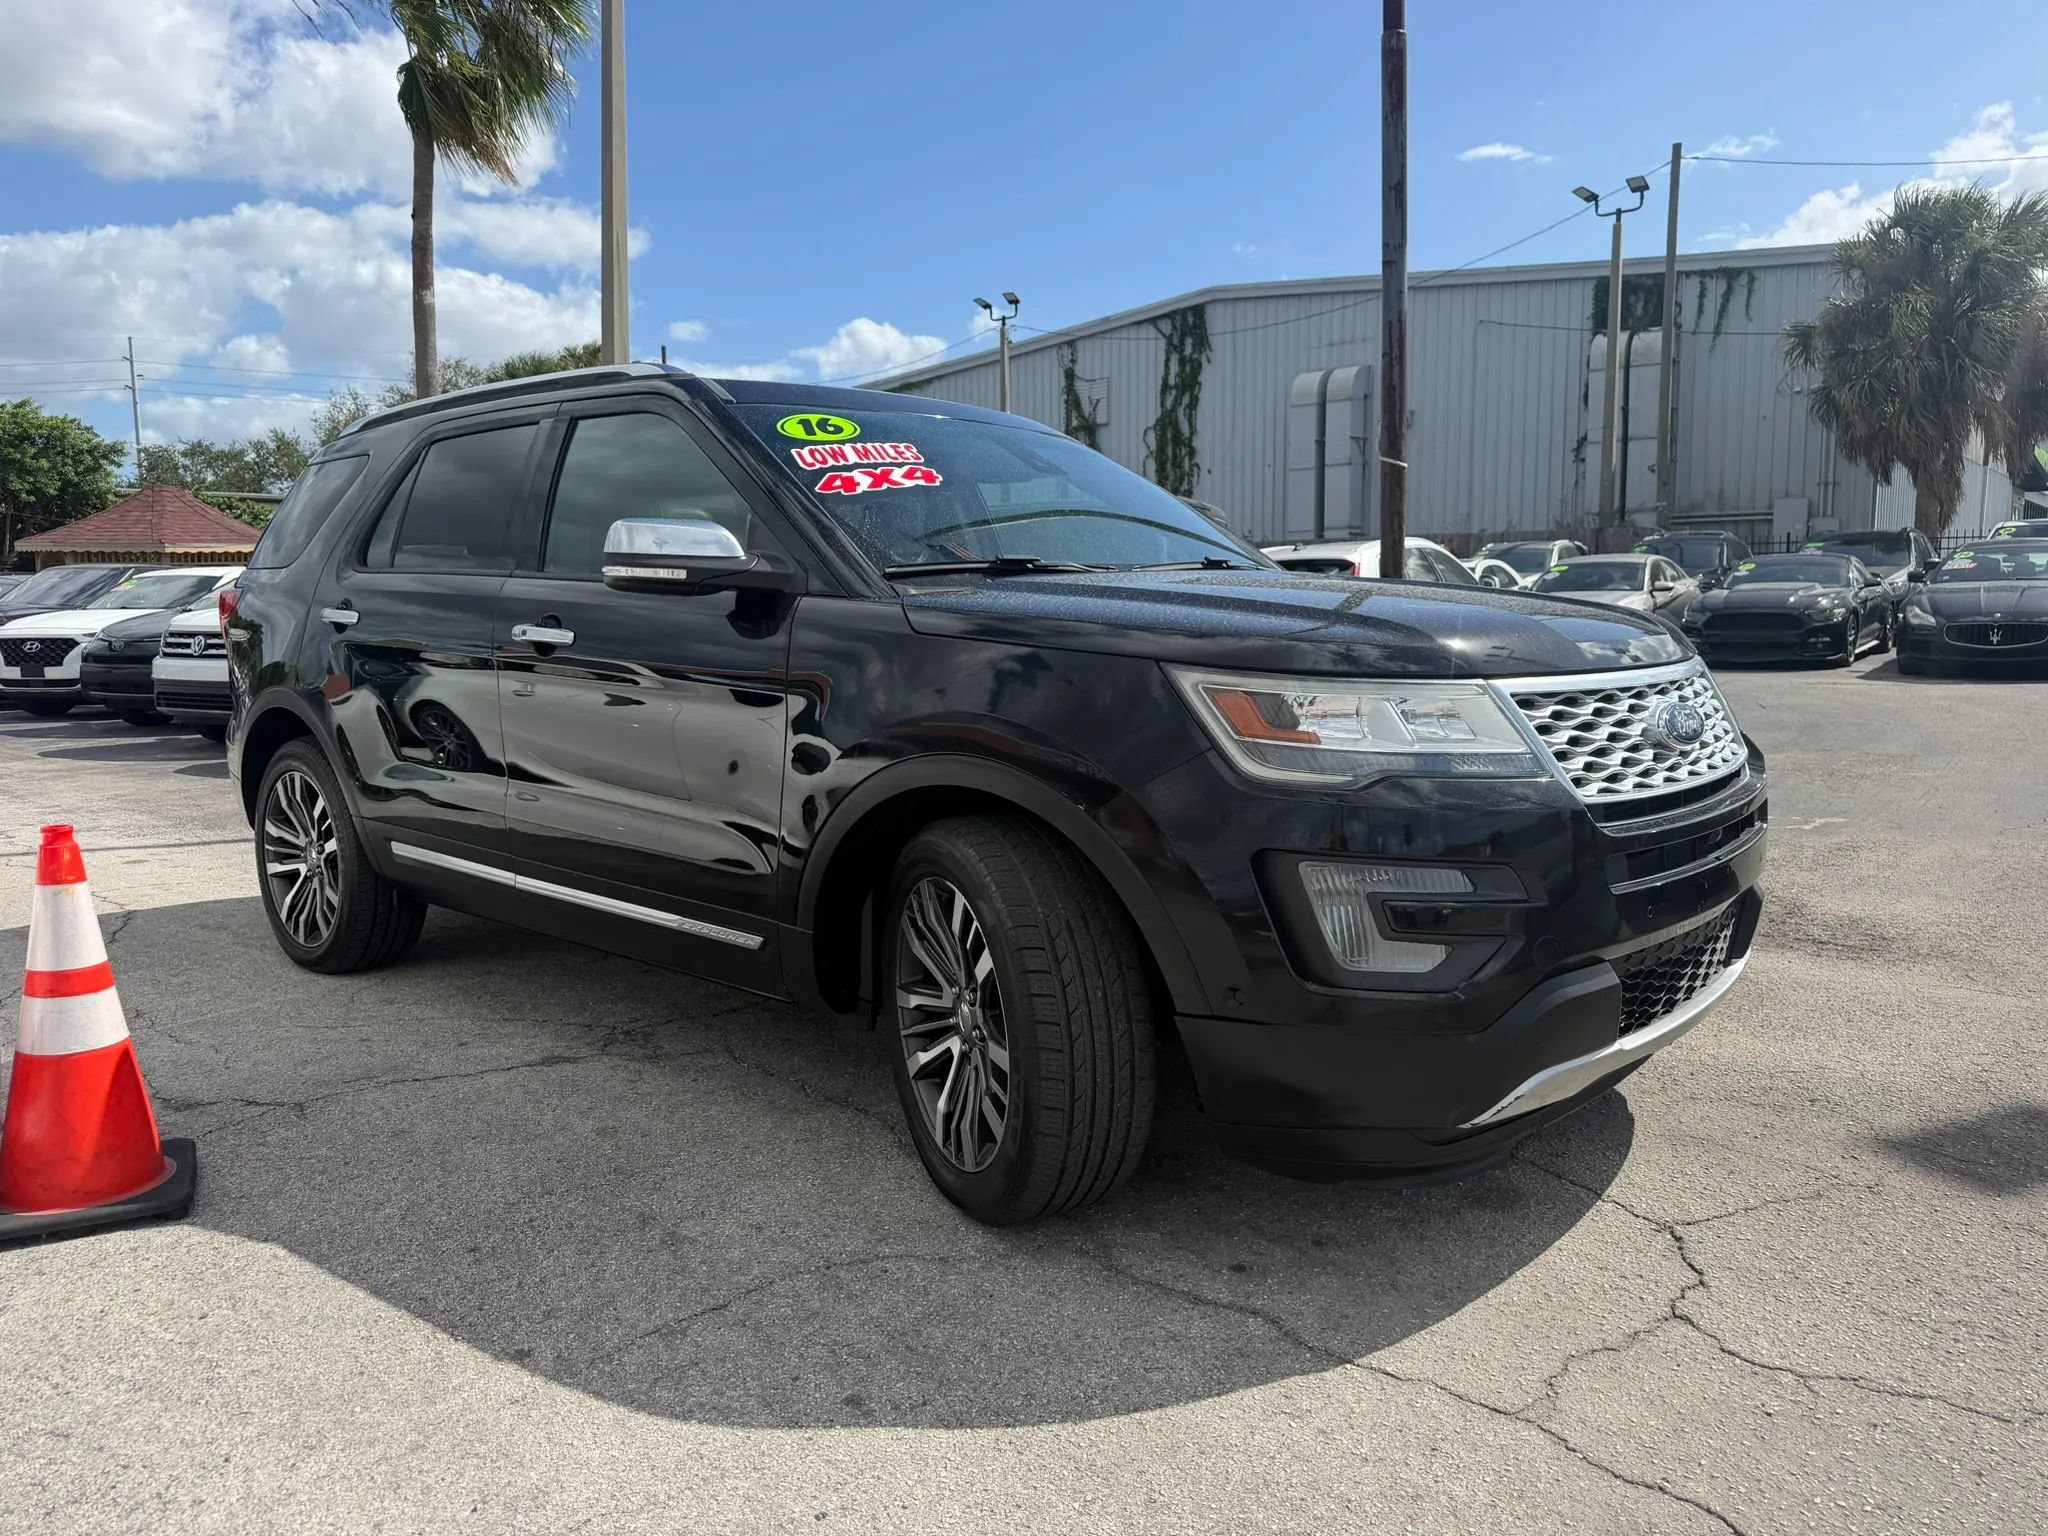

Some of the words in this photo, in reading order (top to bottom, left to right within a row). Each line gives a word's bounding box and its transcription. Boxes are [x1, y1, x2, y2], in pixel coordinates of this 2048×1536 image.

[796, 417, 844, 437] 16
[794, 445, 850, 468] LOW
[851, 442, 923, 463] MILES
[1673, 708, 1701, 737] Ford
